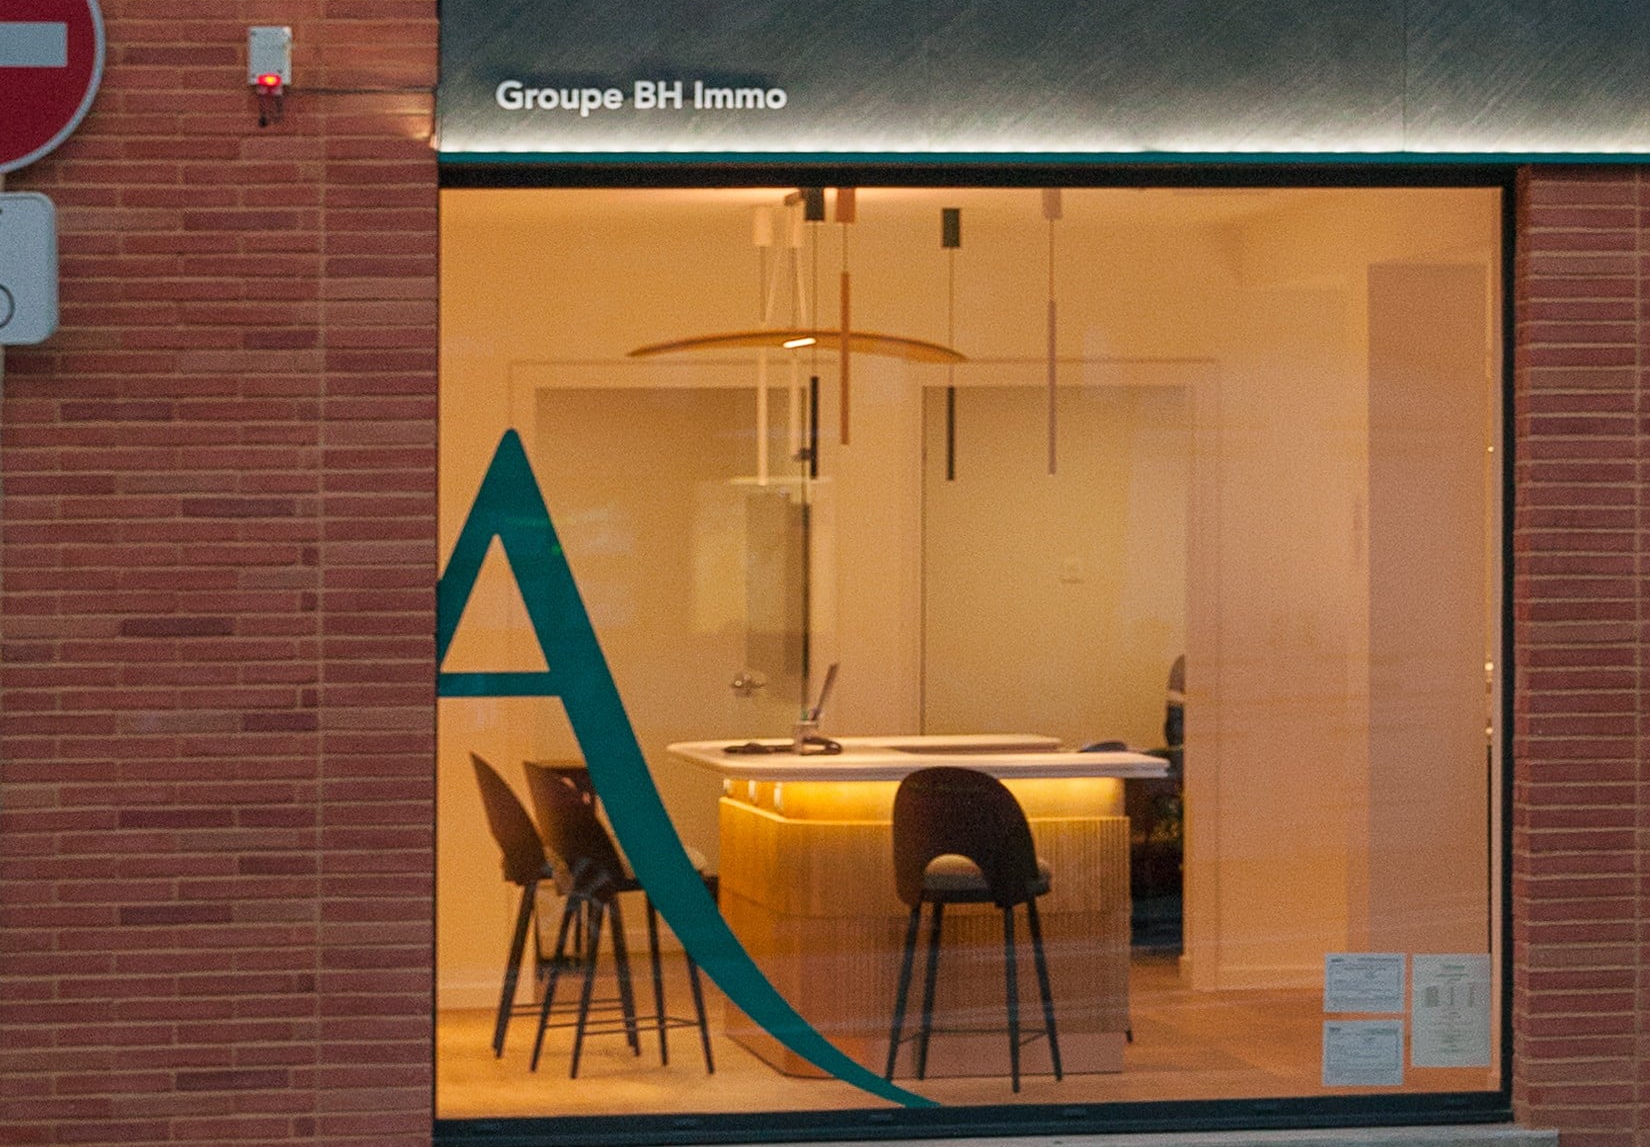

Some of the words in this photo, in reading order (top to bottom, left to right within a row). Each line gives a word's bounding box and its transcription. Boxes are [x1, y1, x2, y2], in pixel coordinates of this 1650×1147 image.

[496, 80, 623, 117] Groupe
[634, 81, 683, 109] BH
[694, 81, 788, 109] Immo
